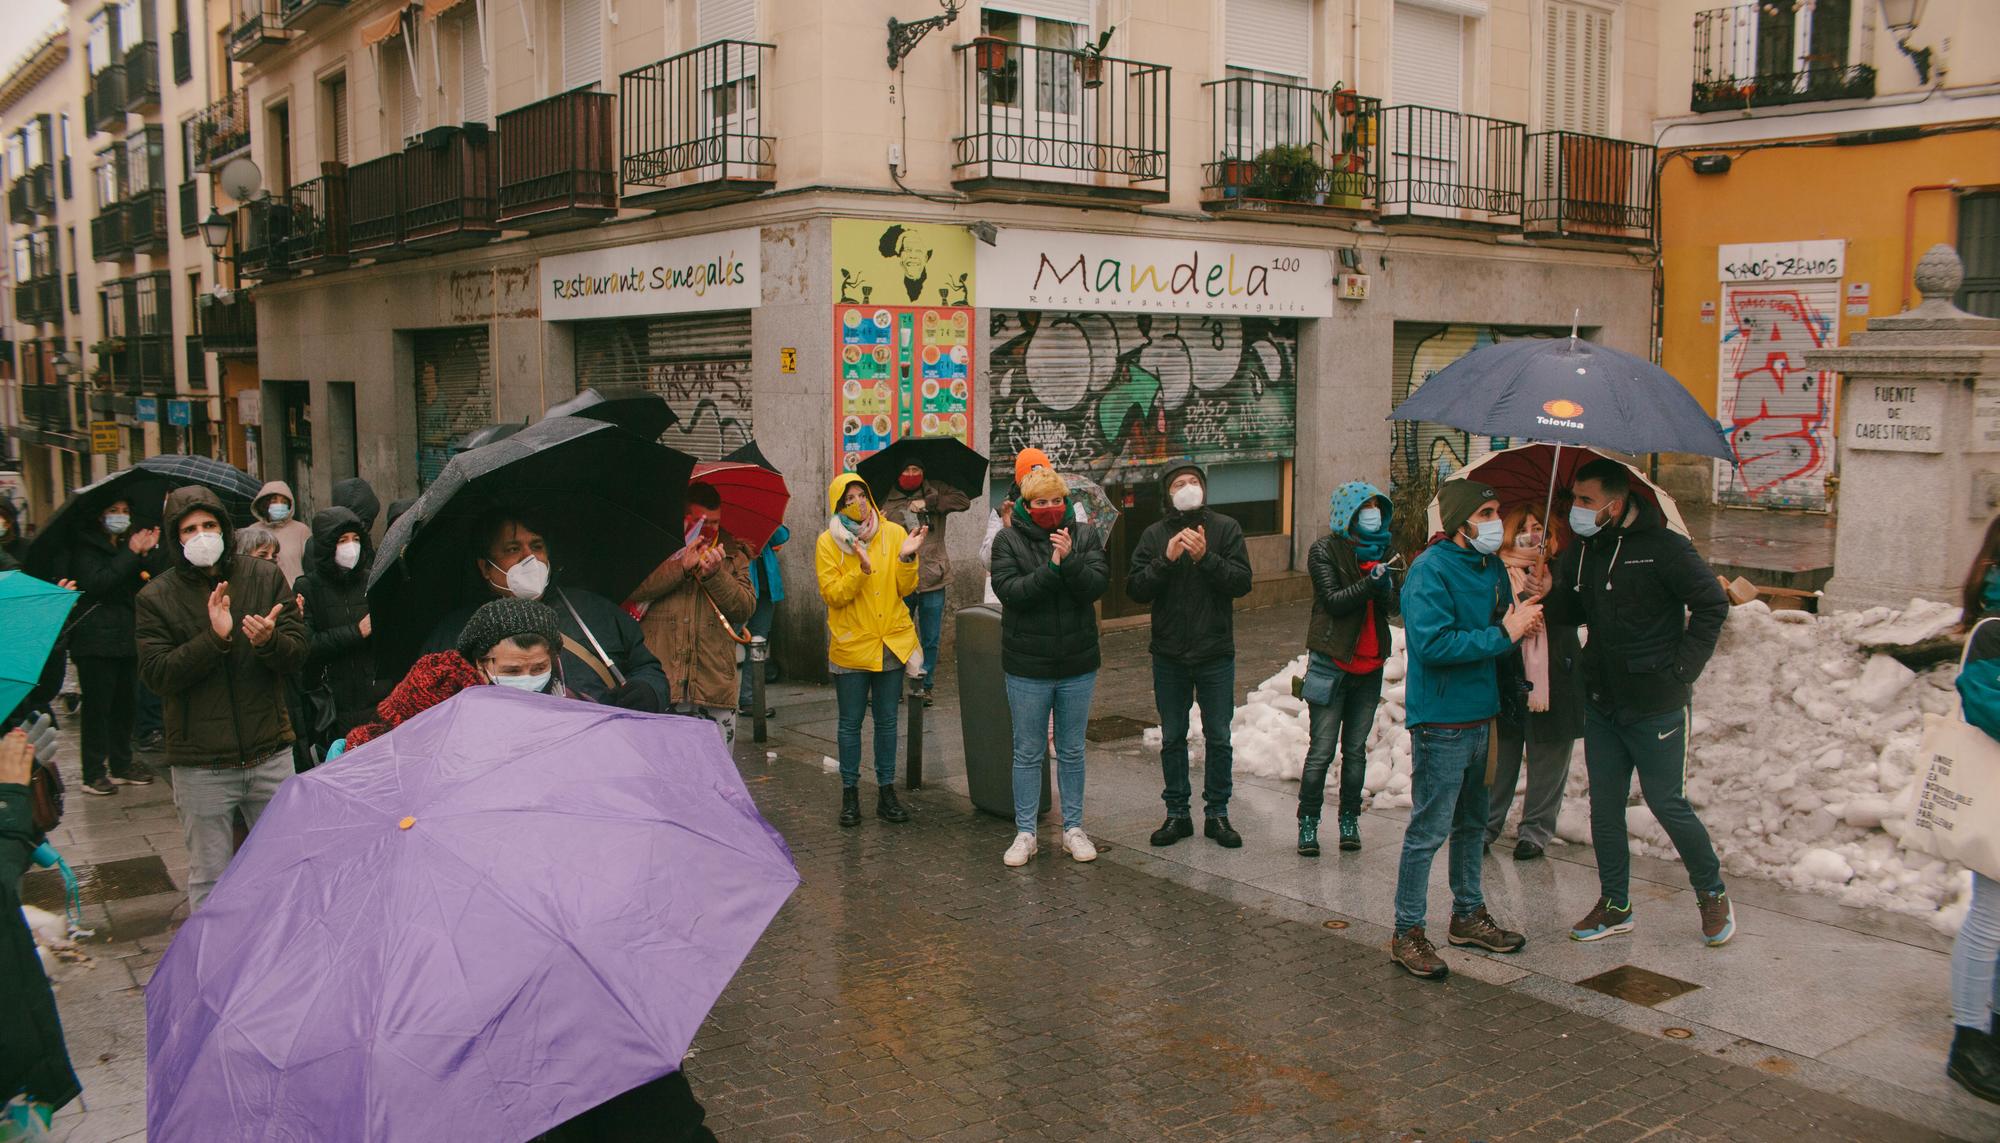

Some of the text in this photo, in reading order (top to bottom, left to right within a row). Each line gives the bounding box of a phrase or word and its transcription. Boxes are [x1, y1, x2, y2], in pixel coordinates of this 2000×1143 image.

[553, 250, 745, 300] Restaurante Senegalés
[1032, 250, 1300, 297] Mandela 100
[1029, 295, 1190, 308] Restaurante
[1875, 386, 1918, 403] FUENTE
[1888, 408, 1901, 419] DE
[1536, 415, 1585, 430] Televisa
[1855, 423, 1933, 441] CABESTREROS
